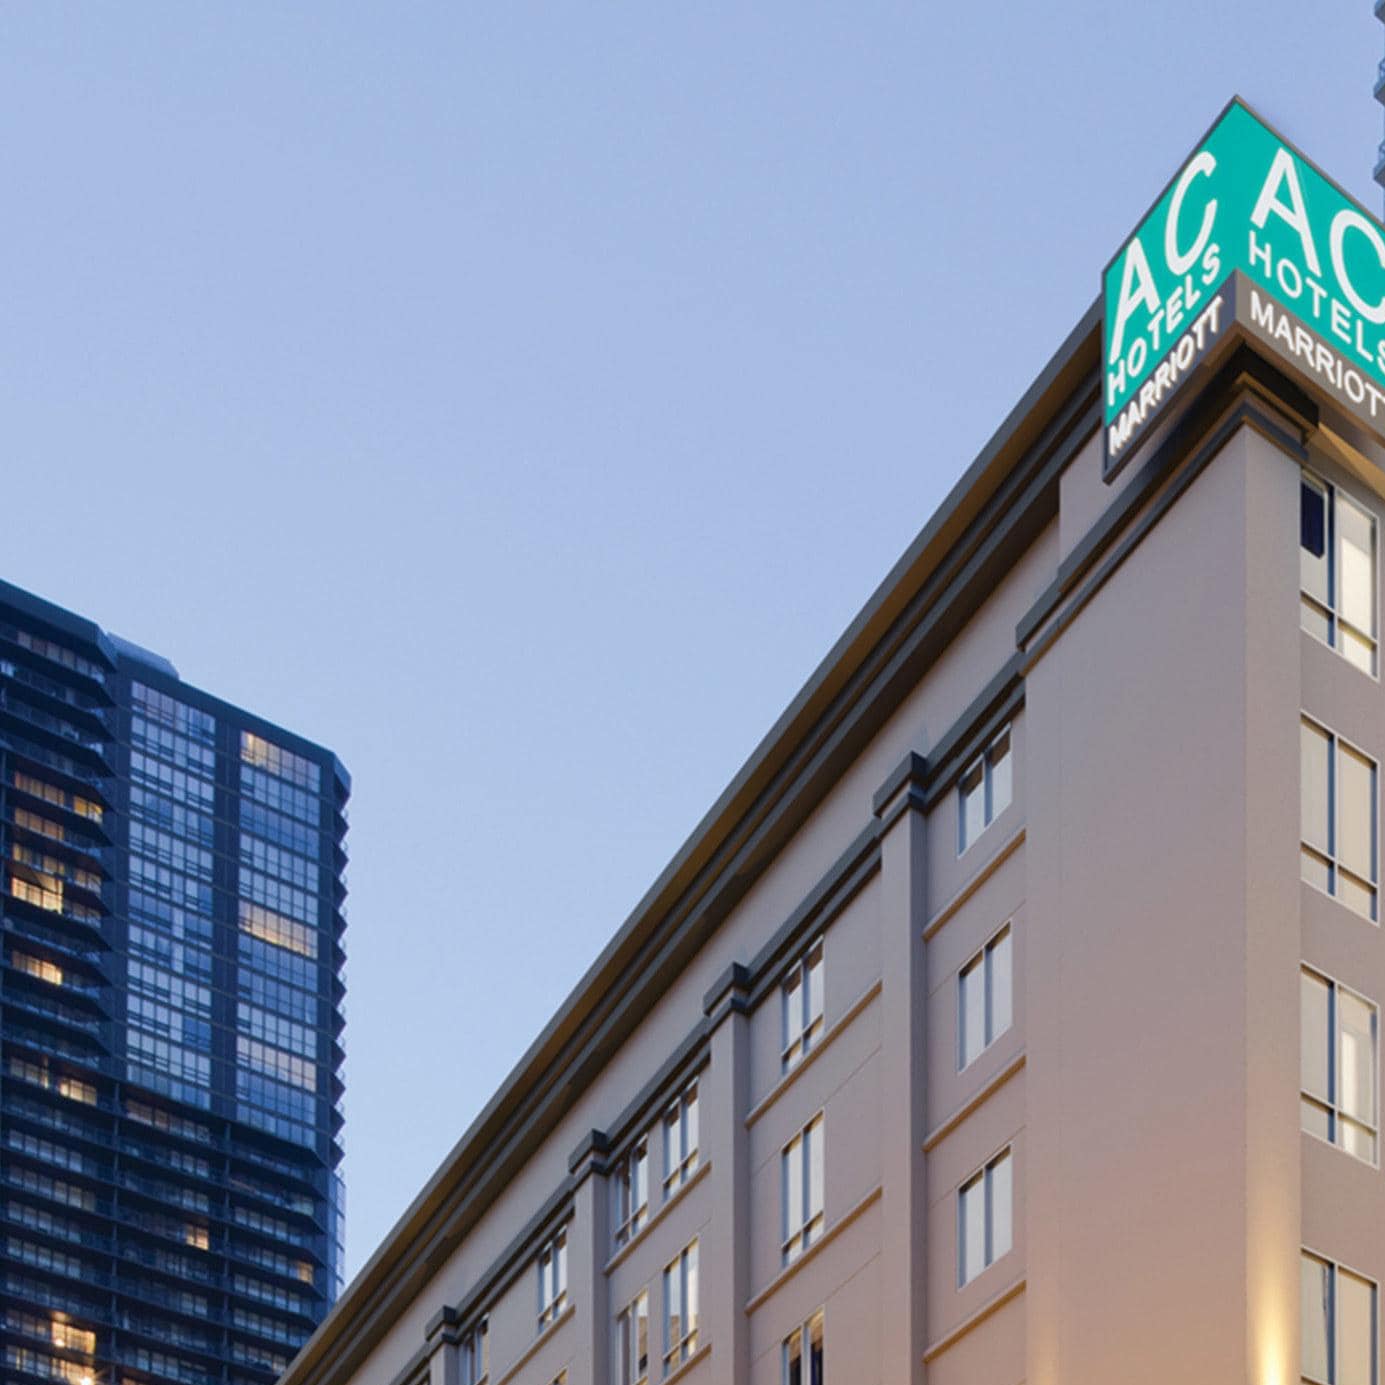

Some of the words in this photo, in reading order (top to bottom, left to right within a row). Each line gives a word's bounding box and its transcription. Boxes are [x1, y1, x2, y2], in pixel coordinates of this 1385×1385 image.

[1108, 243, 1220, 406] HOTELS
[1110, 151, 1217, 364] AC
[1108, 296, 1223, 456] MARRIOTT
